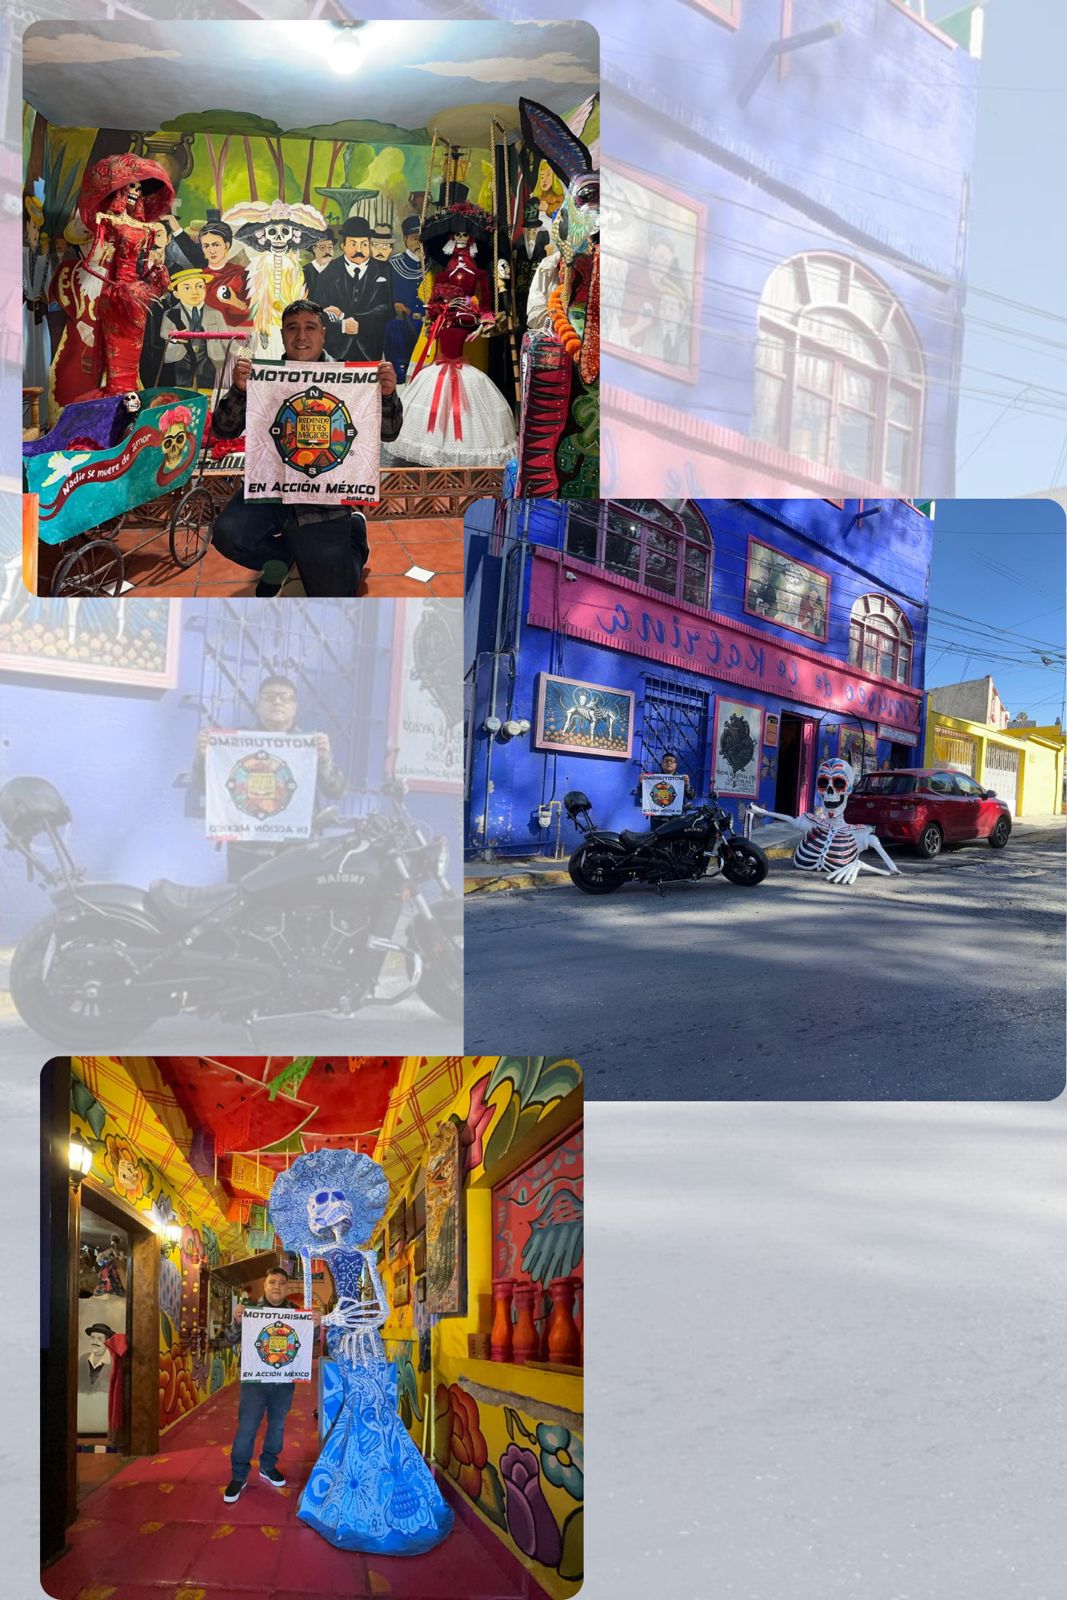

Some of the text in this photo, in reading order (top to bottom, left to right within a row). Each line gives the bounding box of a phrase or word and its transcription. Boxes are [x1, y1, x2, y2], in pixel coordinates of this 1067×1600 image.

[249, 369, 379, 384] MOTOTURISMO
[62, 433, 152, 496] Nadie se muere de amor
[248, 480, 376, 495] EN ACCIÓN MÉXICO
[243, 1310, 312, 1320] MOTOTURISMO
